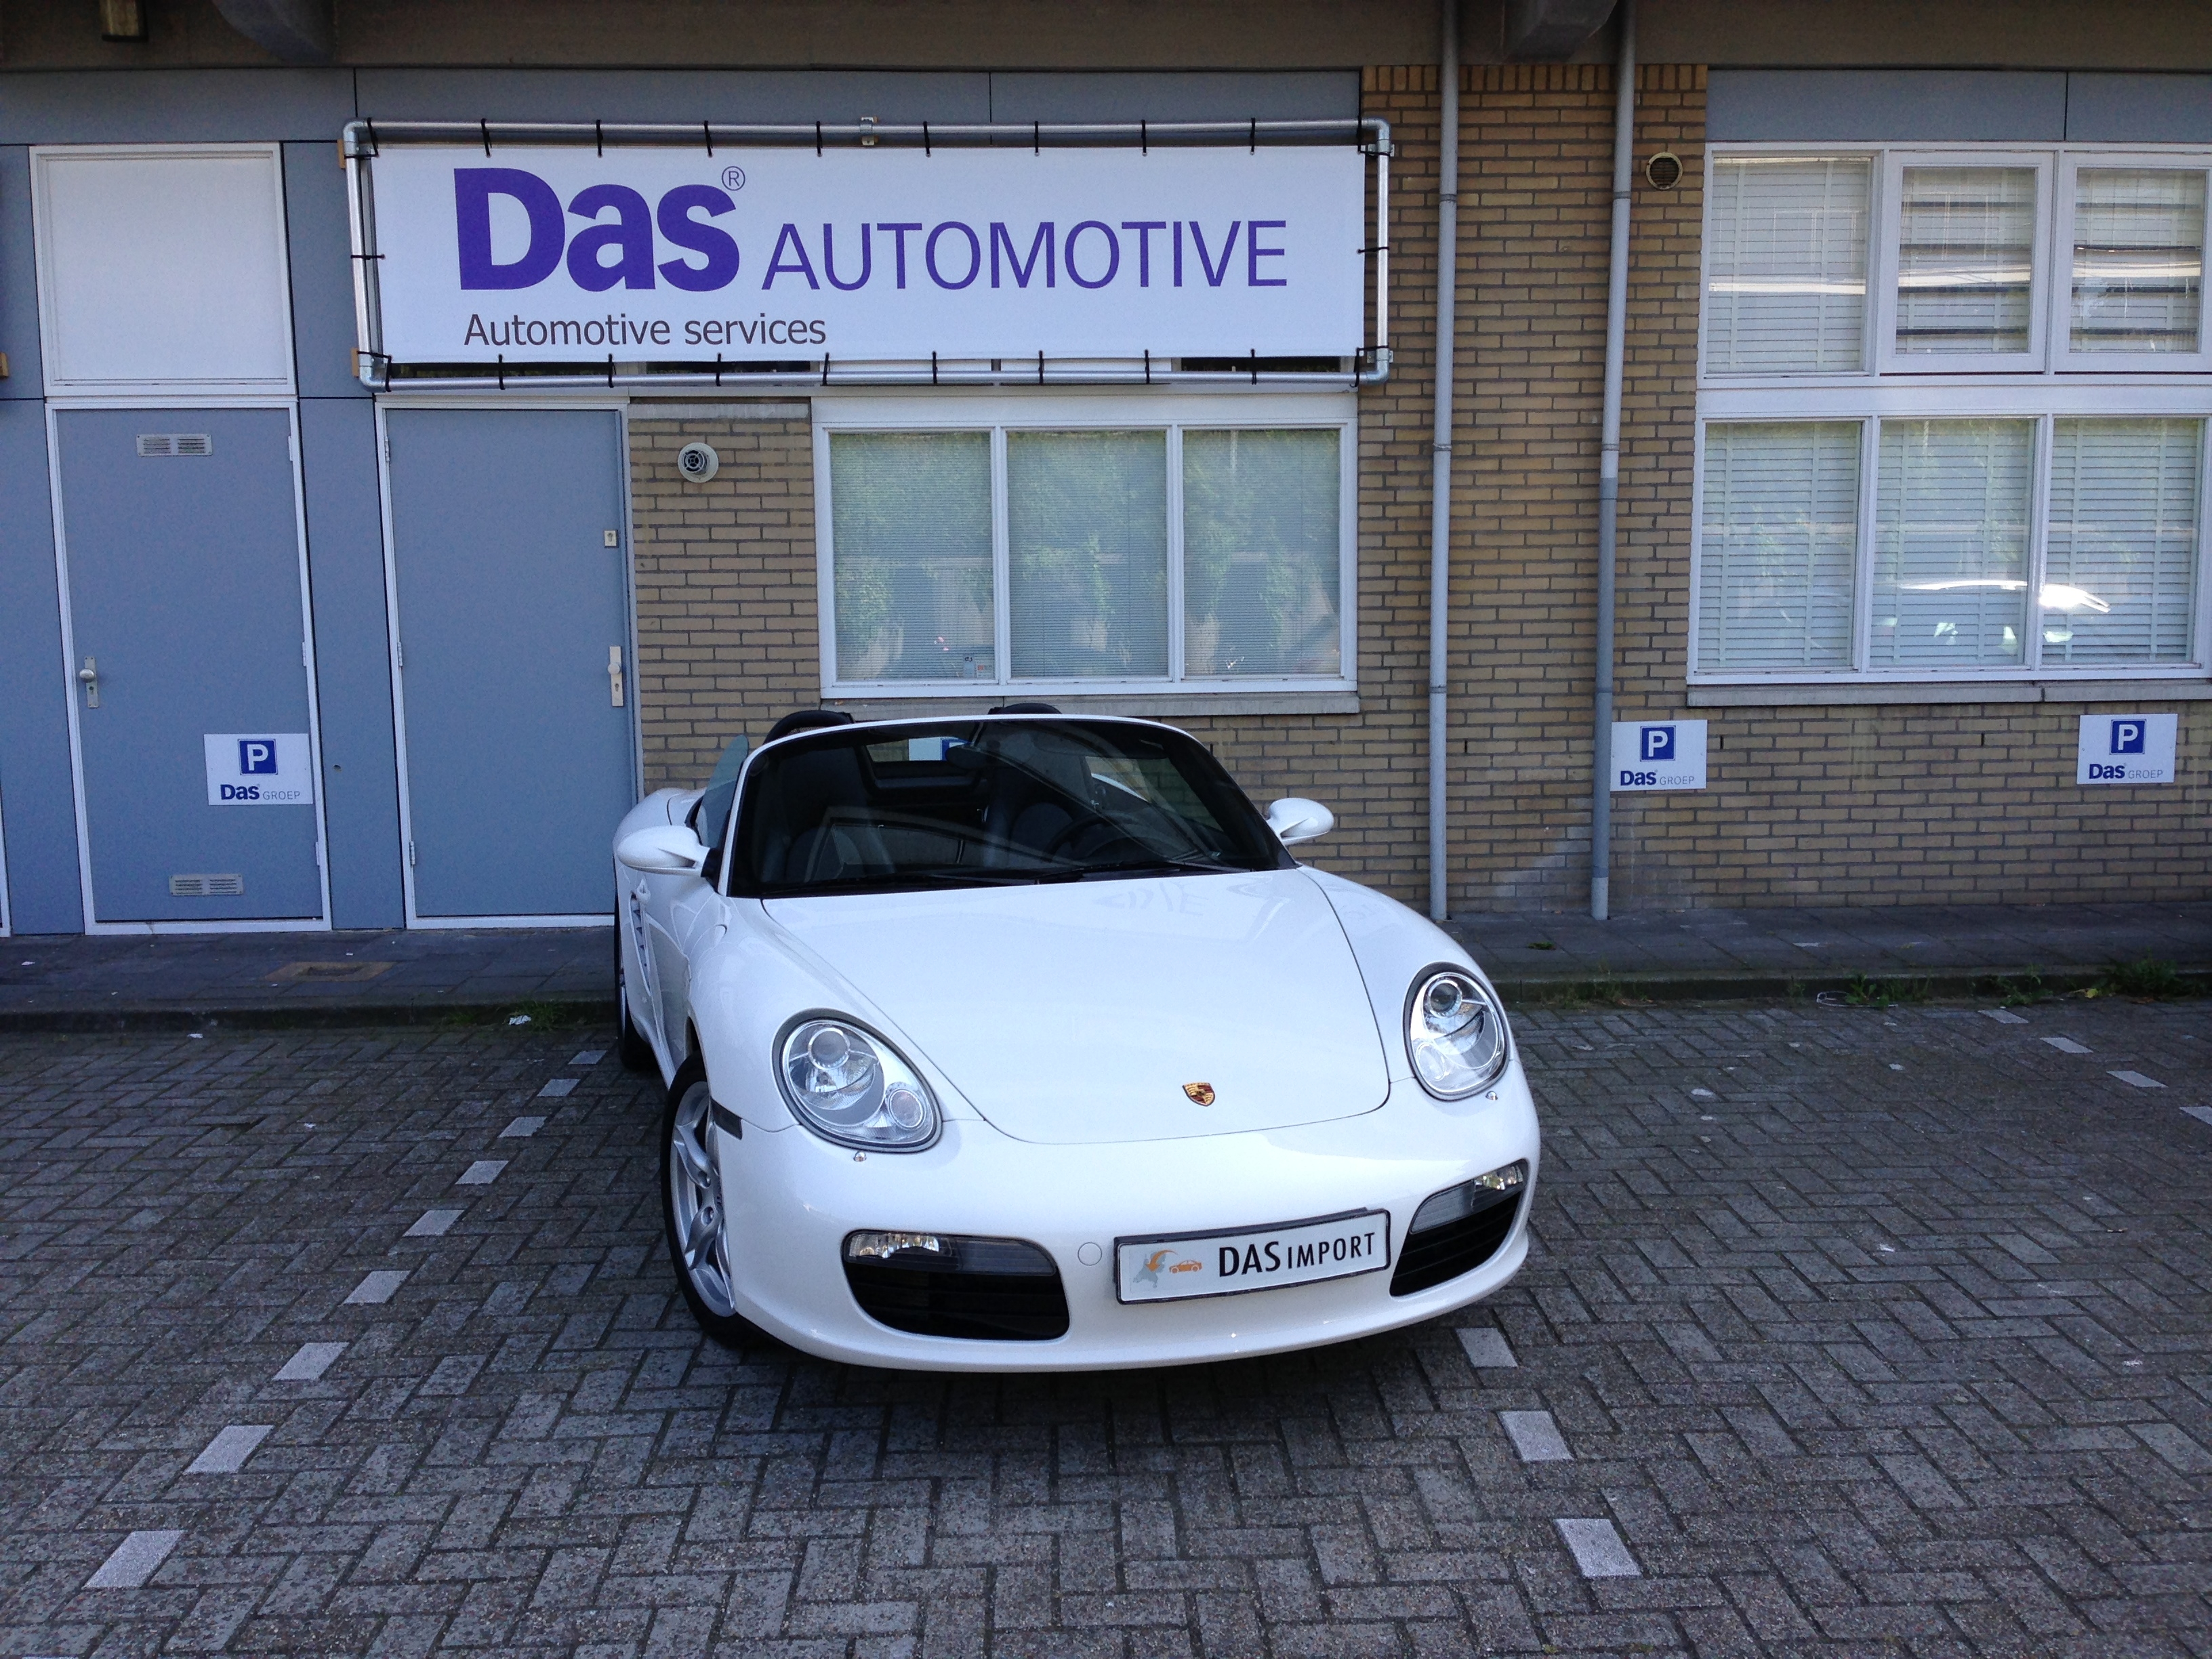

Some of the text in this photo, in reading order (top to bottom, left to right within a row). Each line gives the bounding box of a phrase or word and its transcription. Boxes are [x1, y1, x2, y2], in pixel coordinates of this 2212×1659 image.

[761, 220, 1288, 291] AUTOMOTIVE
[464, 312, 826, 346] Automotive services
[1647, 731, 1668, 758] P
[2118, 724, 2139, 751] P
[247, 743, 268, 771] P
[1620, 770, 1695, 786] Das GROEP
[2089, 763, 2163, 779] Das GROEP
[220, 784, 300, 800] Das GROEP
[1219, 1232, 1375, 1277] DAS IMPORT
